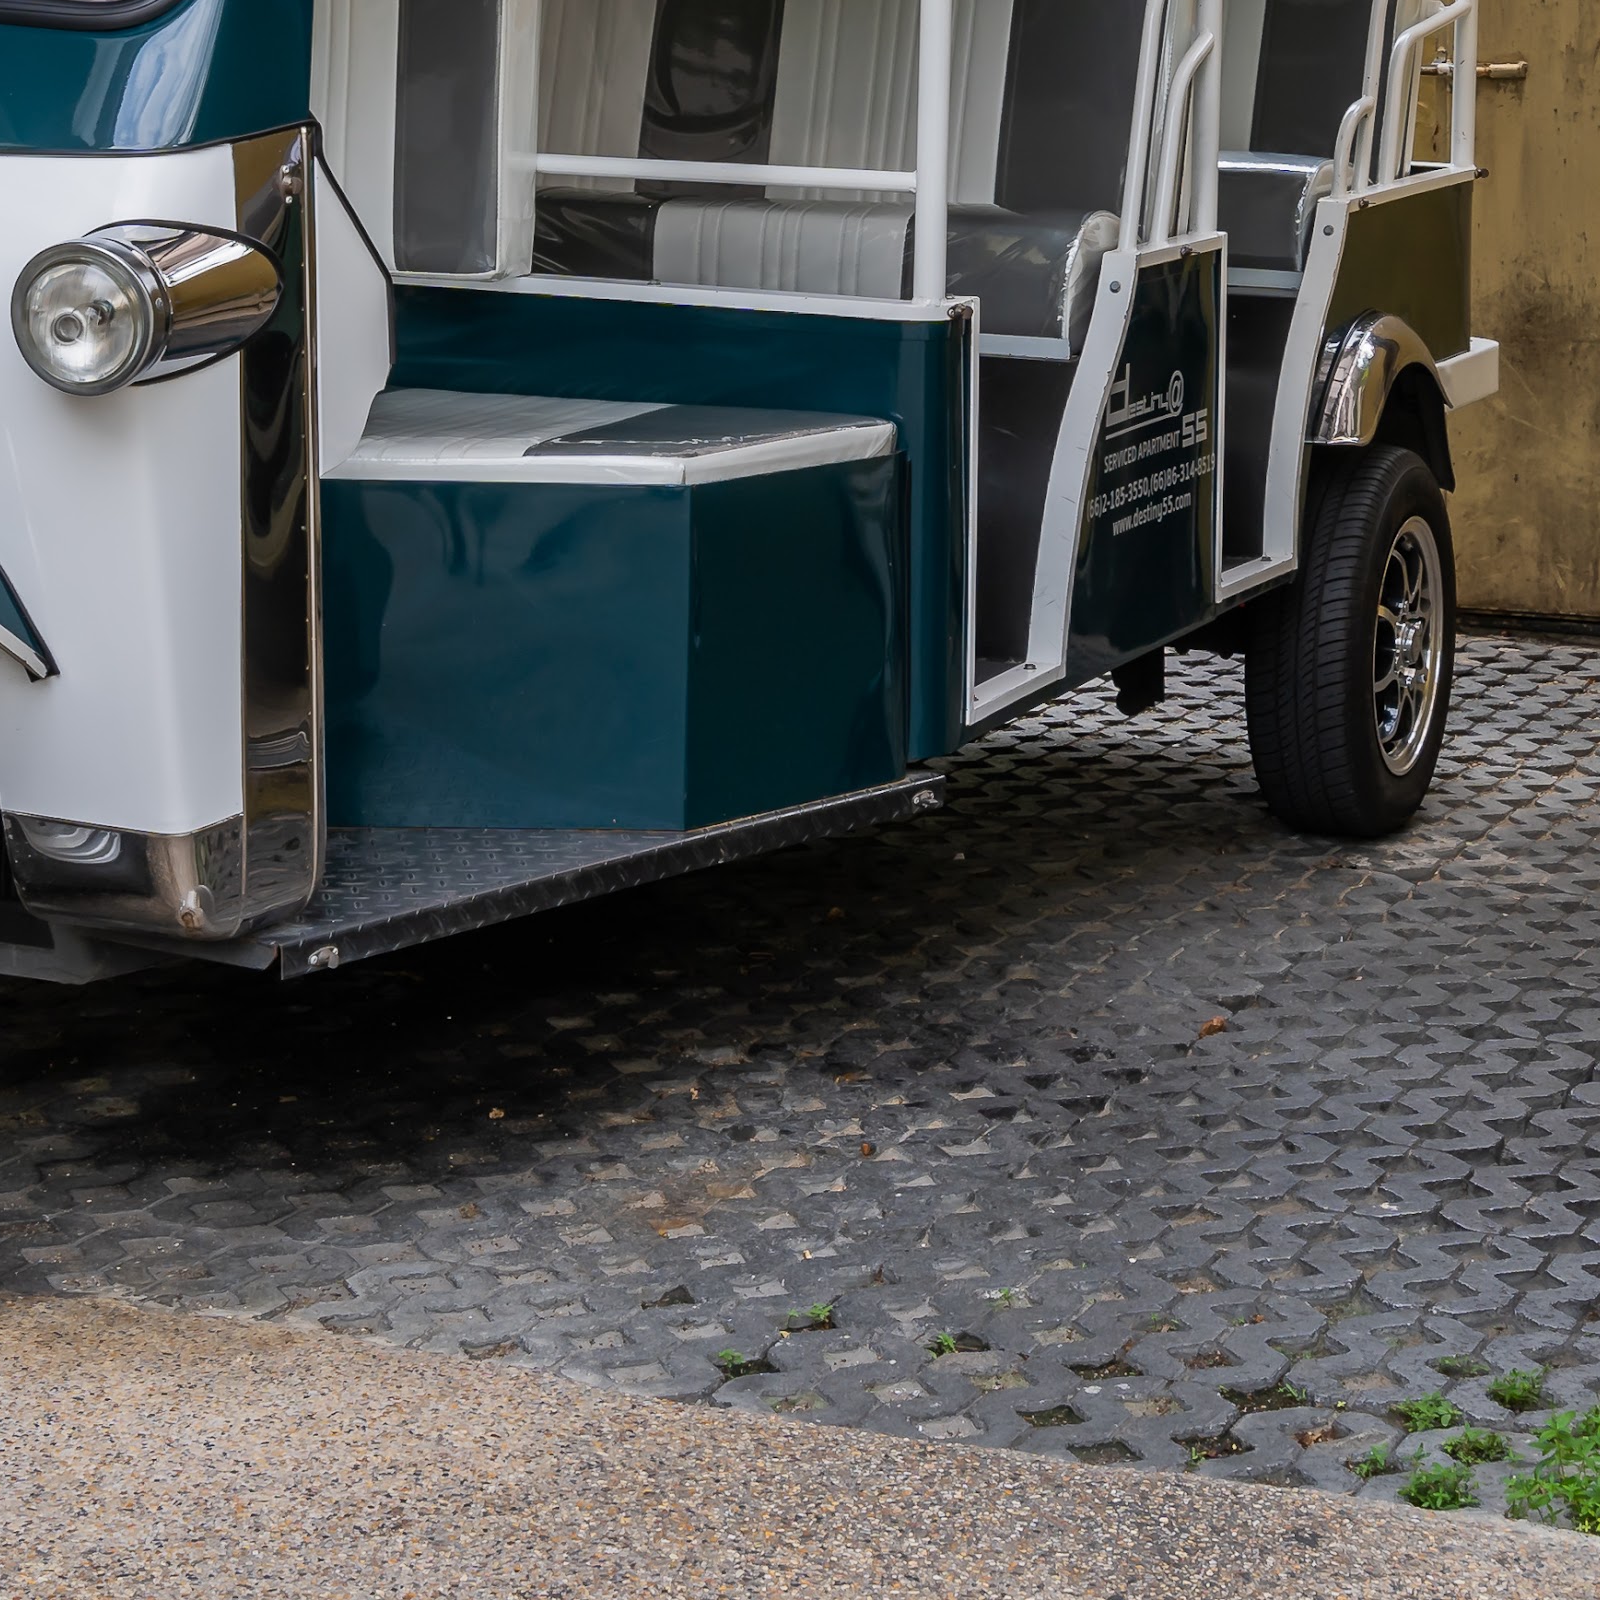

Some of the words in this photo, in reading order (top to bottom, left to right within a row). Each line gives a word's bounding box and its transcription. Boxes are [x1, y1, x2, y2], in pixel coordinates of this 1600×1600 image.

[1182, 408, 1208, 449] 55
[1104, 445, 1137, 474] SERVICED
[1137, 430, 1181, 460] APARTMENT
[1113, 492, 1192, 536] www.destiny55.com
